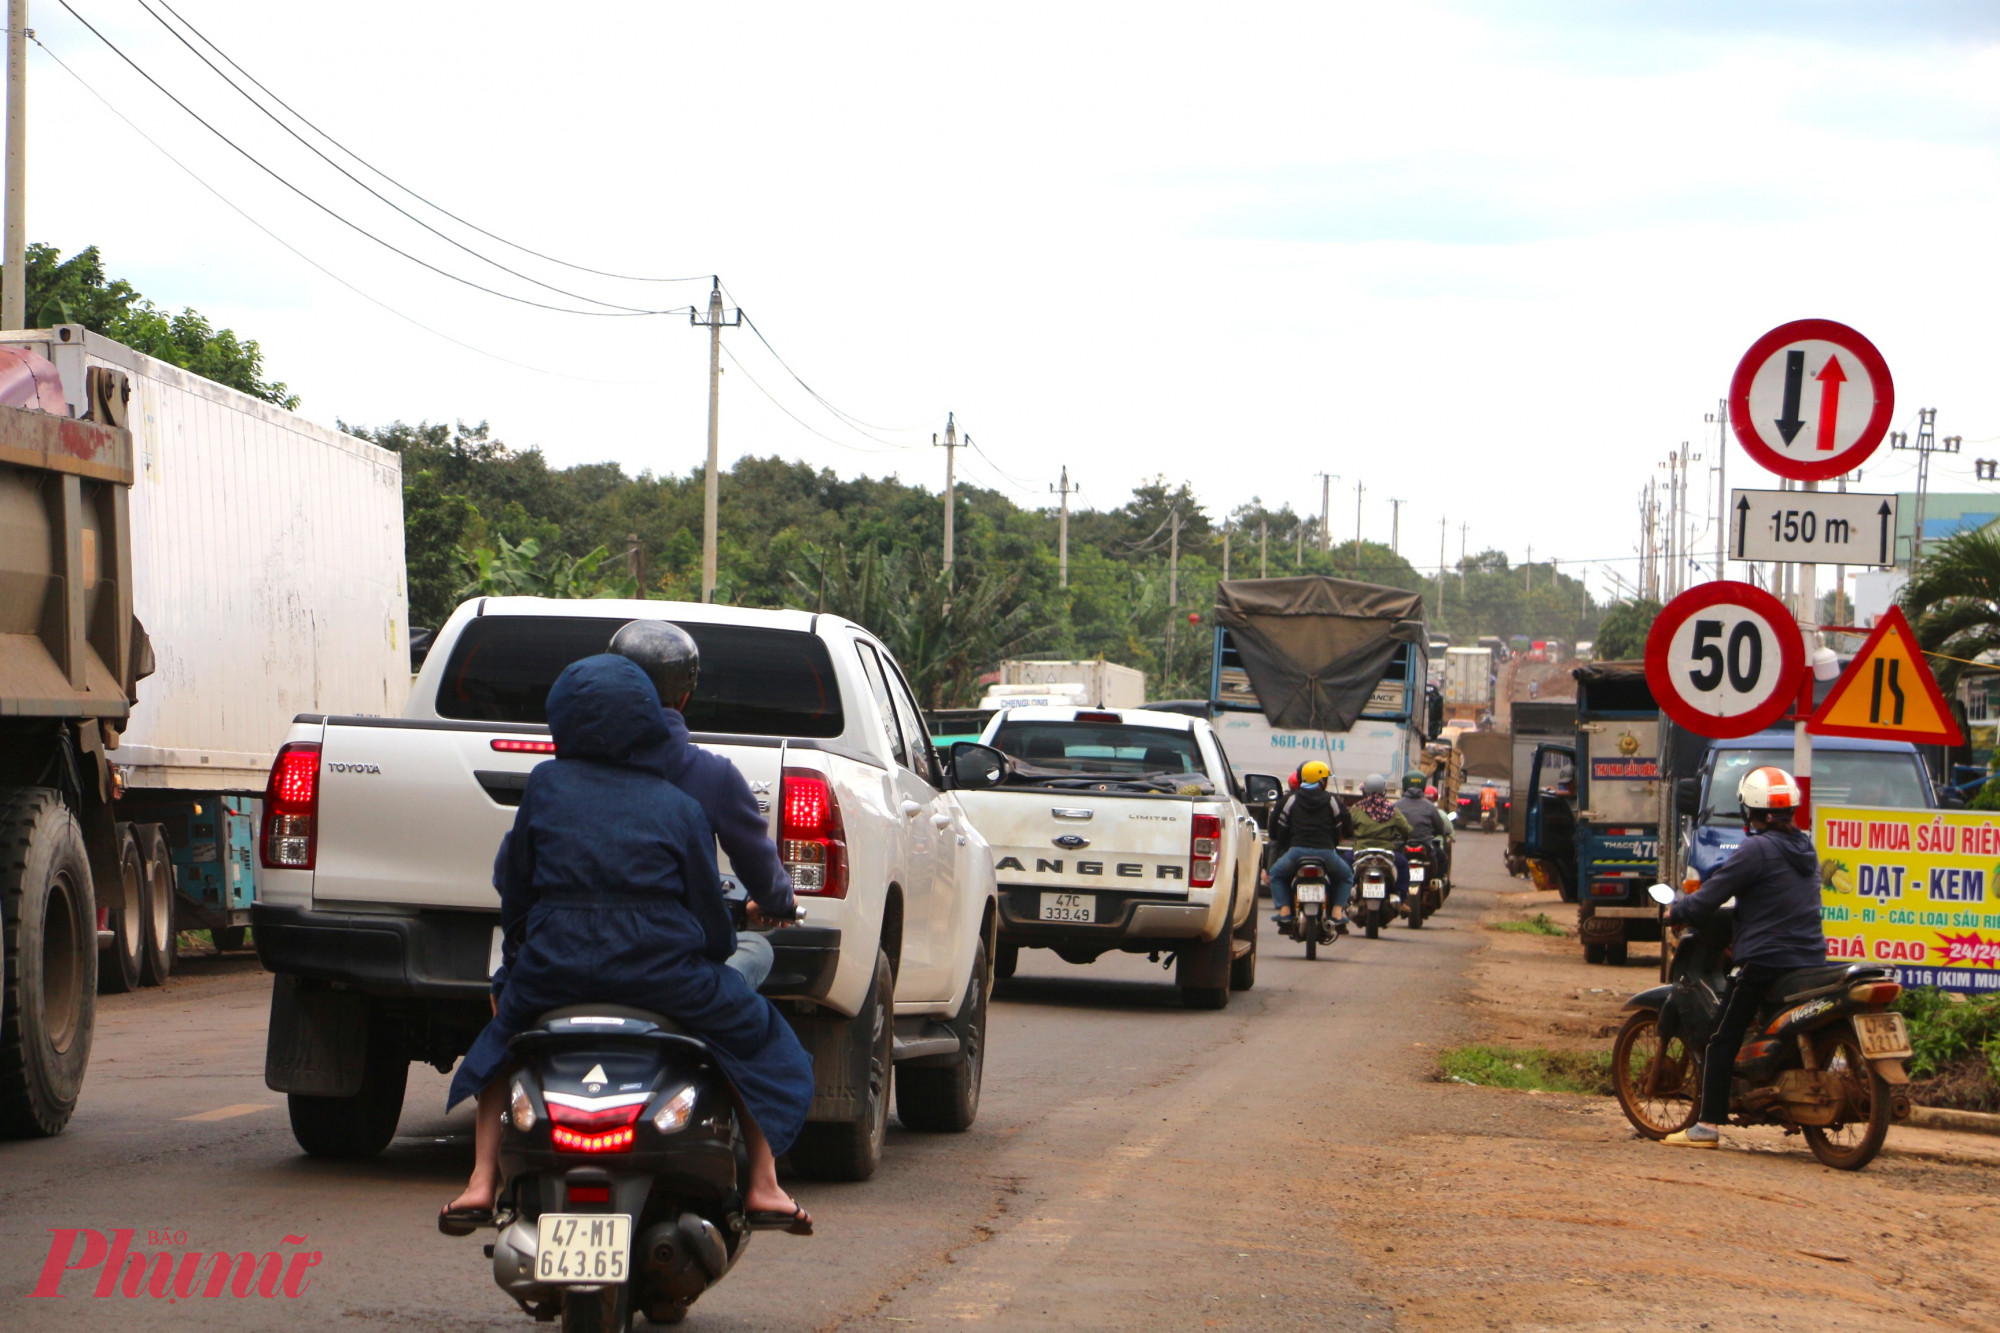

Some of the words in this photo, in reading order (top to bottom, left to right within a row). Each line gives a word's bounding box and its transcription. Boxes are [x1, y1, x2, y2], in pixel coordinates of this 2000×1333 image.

[1771, 510, 1816, 543] 150
[1825, 519, 1849, 543] m
[1689, 619, 1762, 694] 50
[328, 762, 381, 775] TOYOTA
[1128, 814, 1177, 822] LIMITED
[1060, 835, 1080, 844] Ford
[1826, 820, 1863, 849] THU
[1868, 822, 1910, 851] MUA
[995, 856, 1184, 880] ANGER
[1858, 864, 1905, 904] DẠT
[1929, 868, 1984, 901] KEM
[1056, 894, 1081, 907] 47C
[1045, 907, 1090, 922] 333.49
[1821, 905, 1849, 921] THÁI
[1862, 908, 1876, 923] RI
[1889, 907, 1915, 925] CÁC
[1919, 911, 1948, 929] LOẠI
[1825, 935, 1866, 958] GIÁ
[1874, 940, 1925, 961] CAO
[1906, 970, 1932, 985] 116
[1937, 971, 1971, 988] (KIM
[1974, 972, 2000, 989] MU
[551, 1219, 615, 1248] 47-M1
[540, 1250, 624, 1278] 643.65
